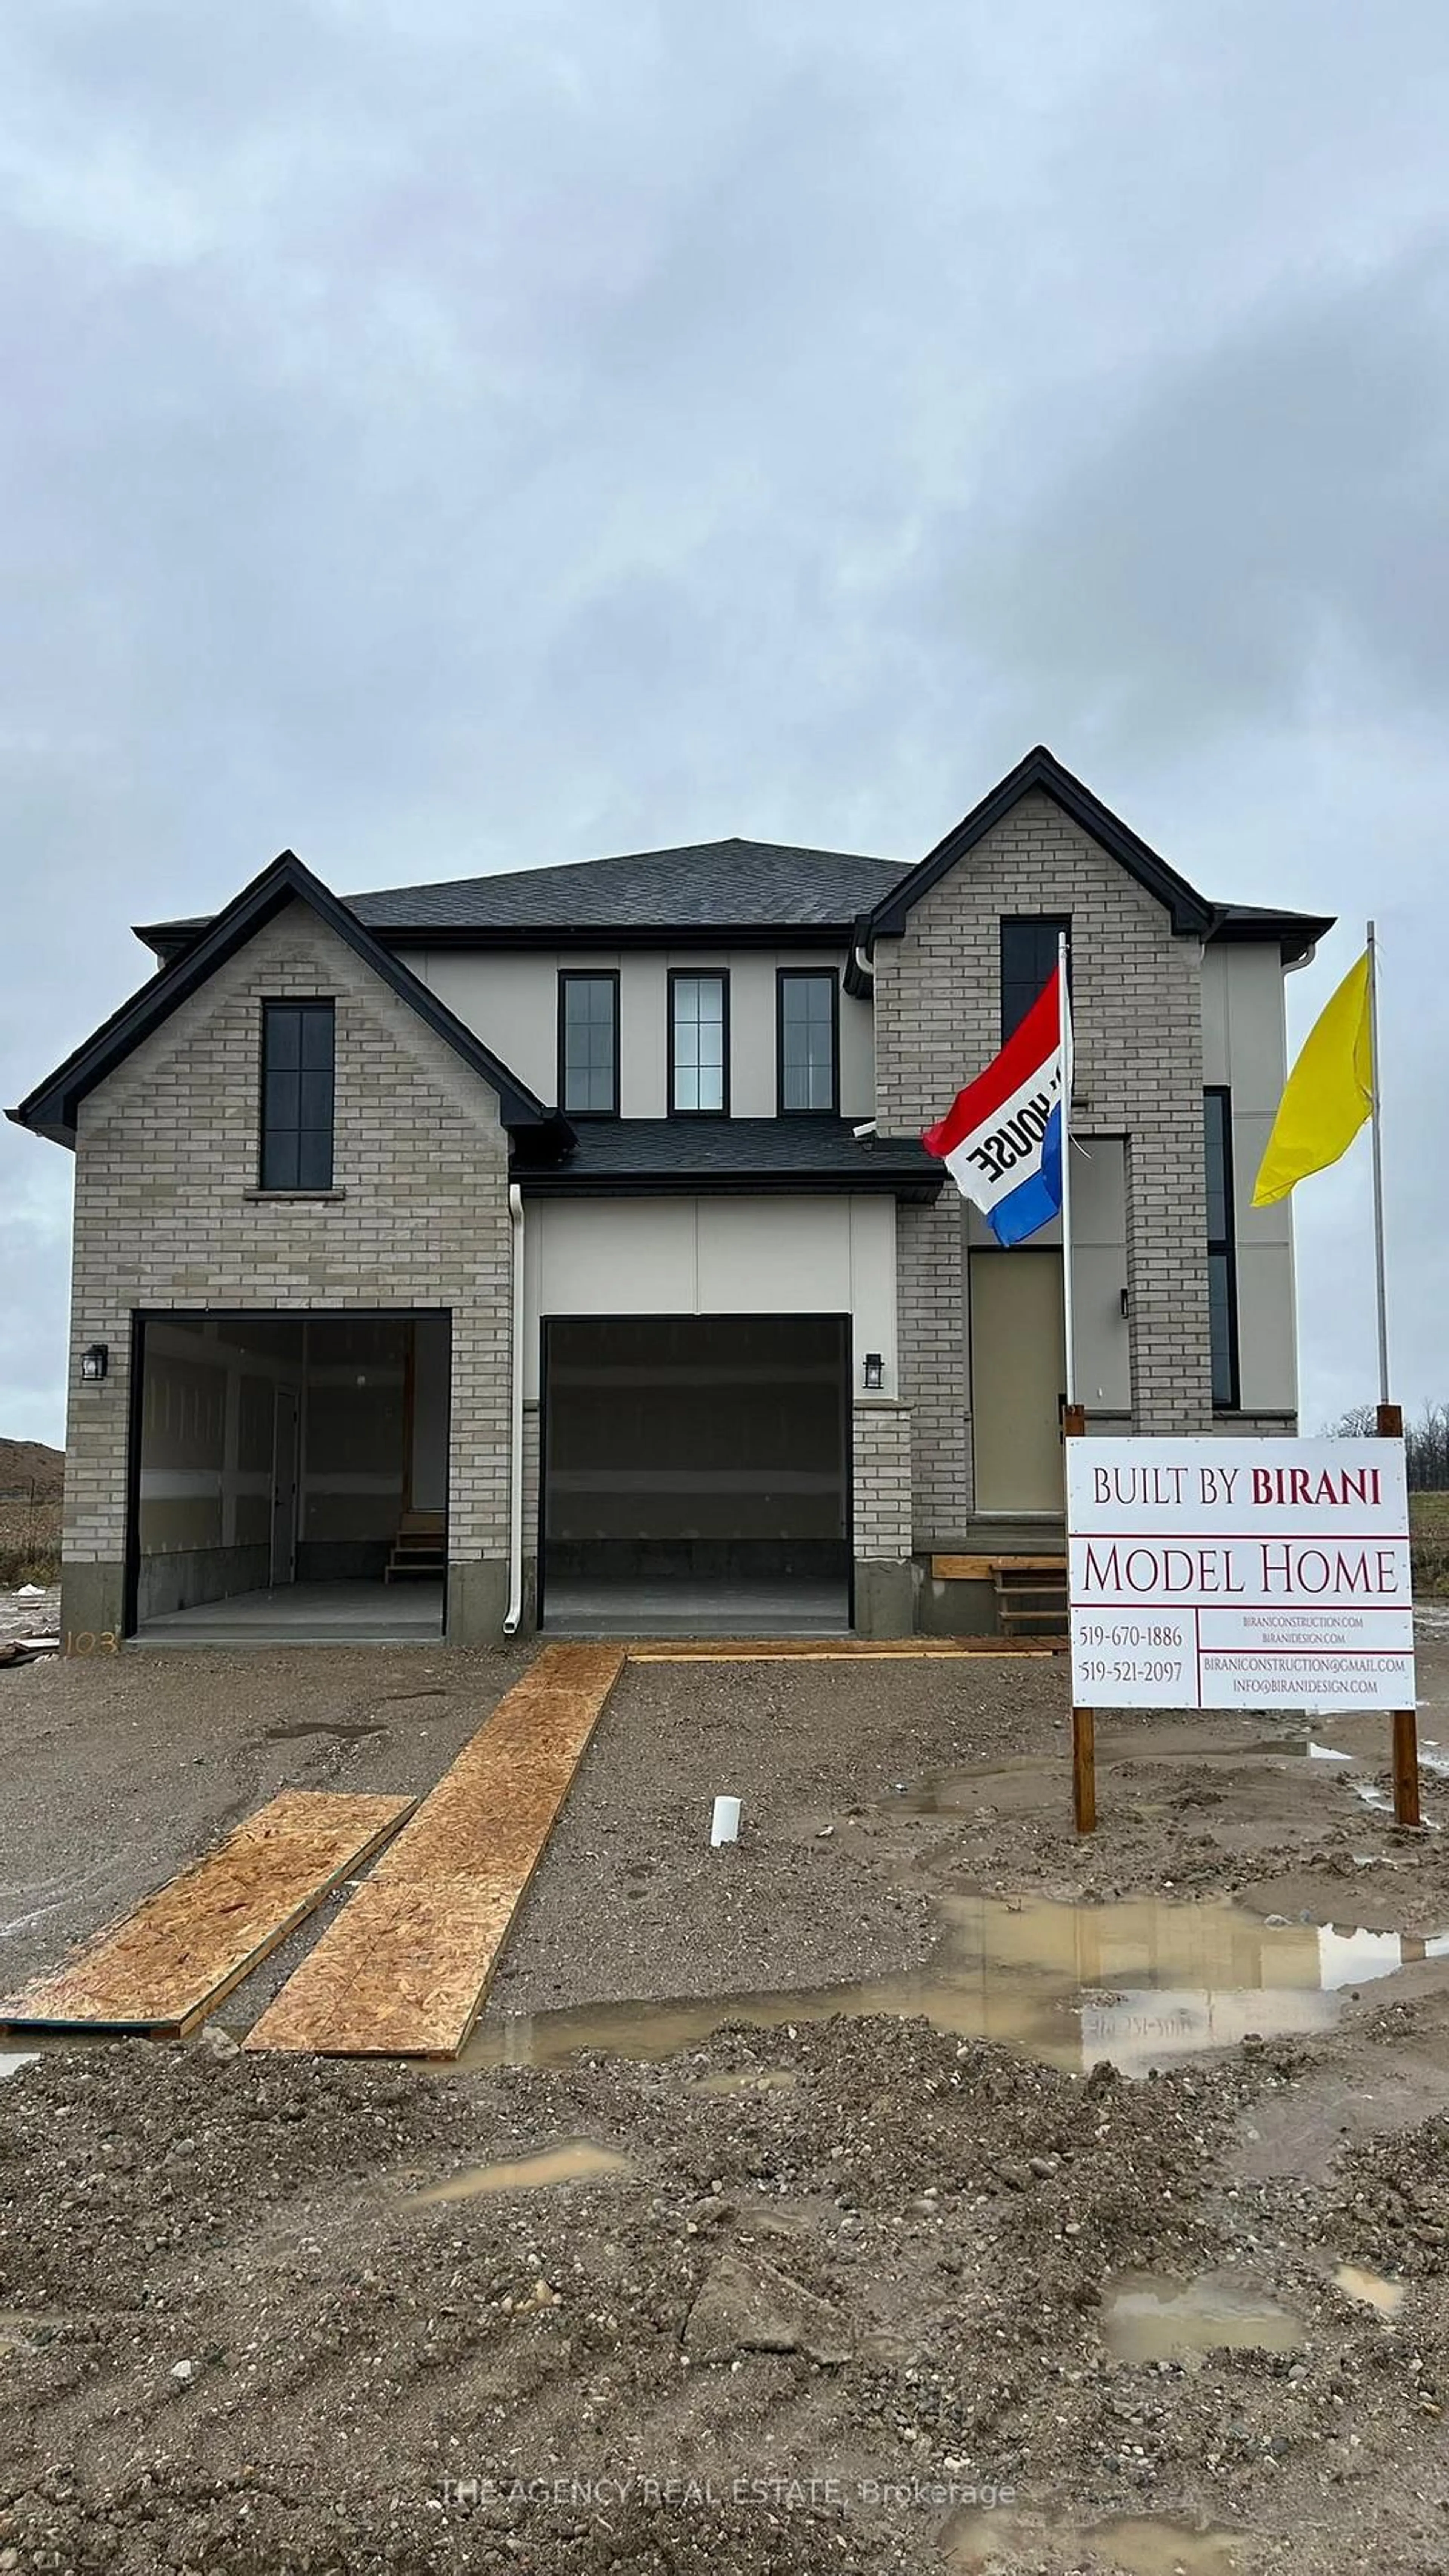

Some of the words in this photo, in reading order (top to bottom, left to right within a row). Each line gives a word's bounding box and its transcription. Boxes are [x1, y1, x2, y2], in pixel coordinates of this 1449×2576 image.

[1093, 1467, 1188, 1504] BUILT
[1200, 1468, 1240, 1504] BY
[1252, 1469, 1381, 1505] BIRANI
[1081, 1543, 1246, 1592] MODEL
[1260, 1544, 1398, 1593] HOME
[1243, 1616, 1364, 1628] BIRANICONSTRUCTION.COM
[66, 1630, 118, 1656] 103
[1080, 1626, 1182, 1646] 519-670-1886
[1262, 1633, 1346, 1644] BIRANIDESIGN.COM
[1081, 1661, 1182, 1681] 519-521-2097
[1204, 1658, 1405, 1673] BIRANICONSTRUCTION@GMAIL.COM
[1234, 1680, 1378, 1694] INFO@BIRANIDESIGN.COM
